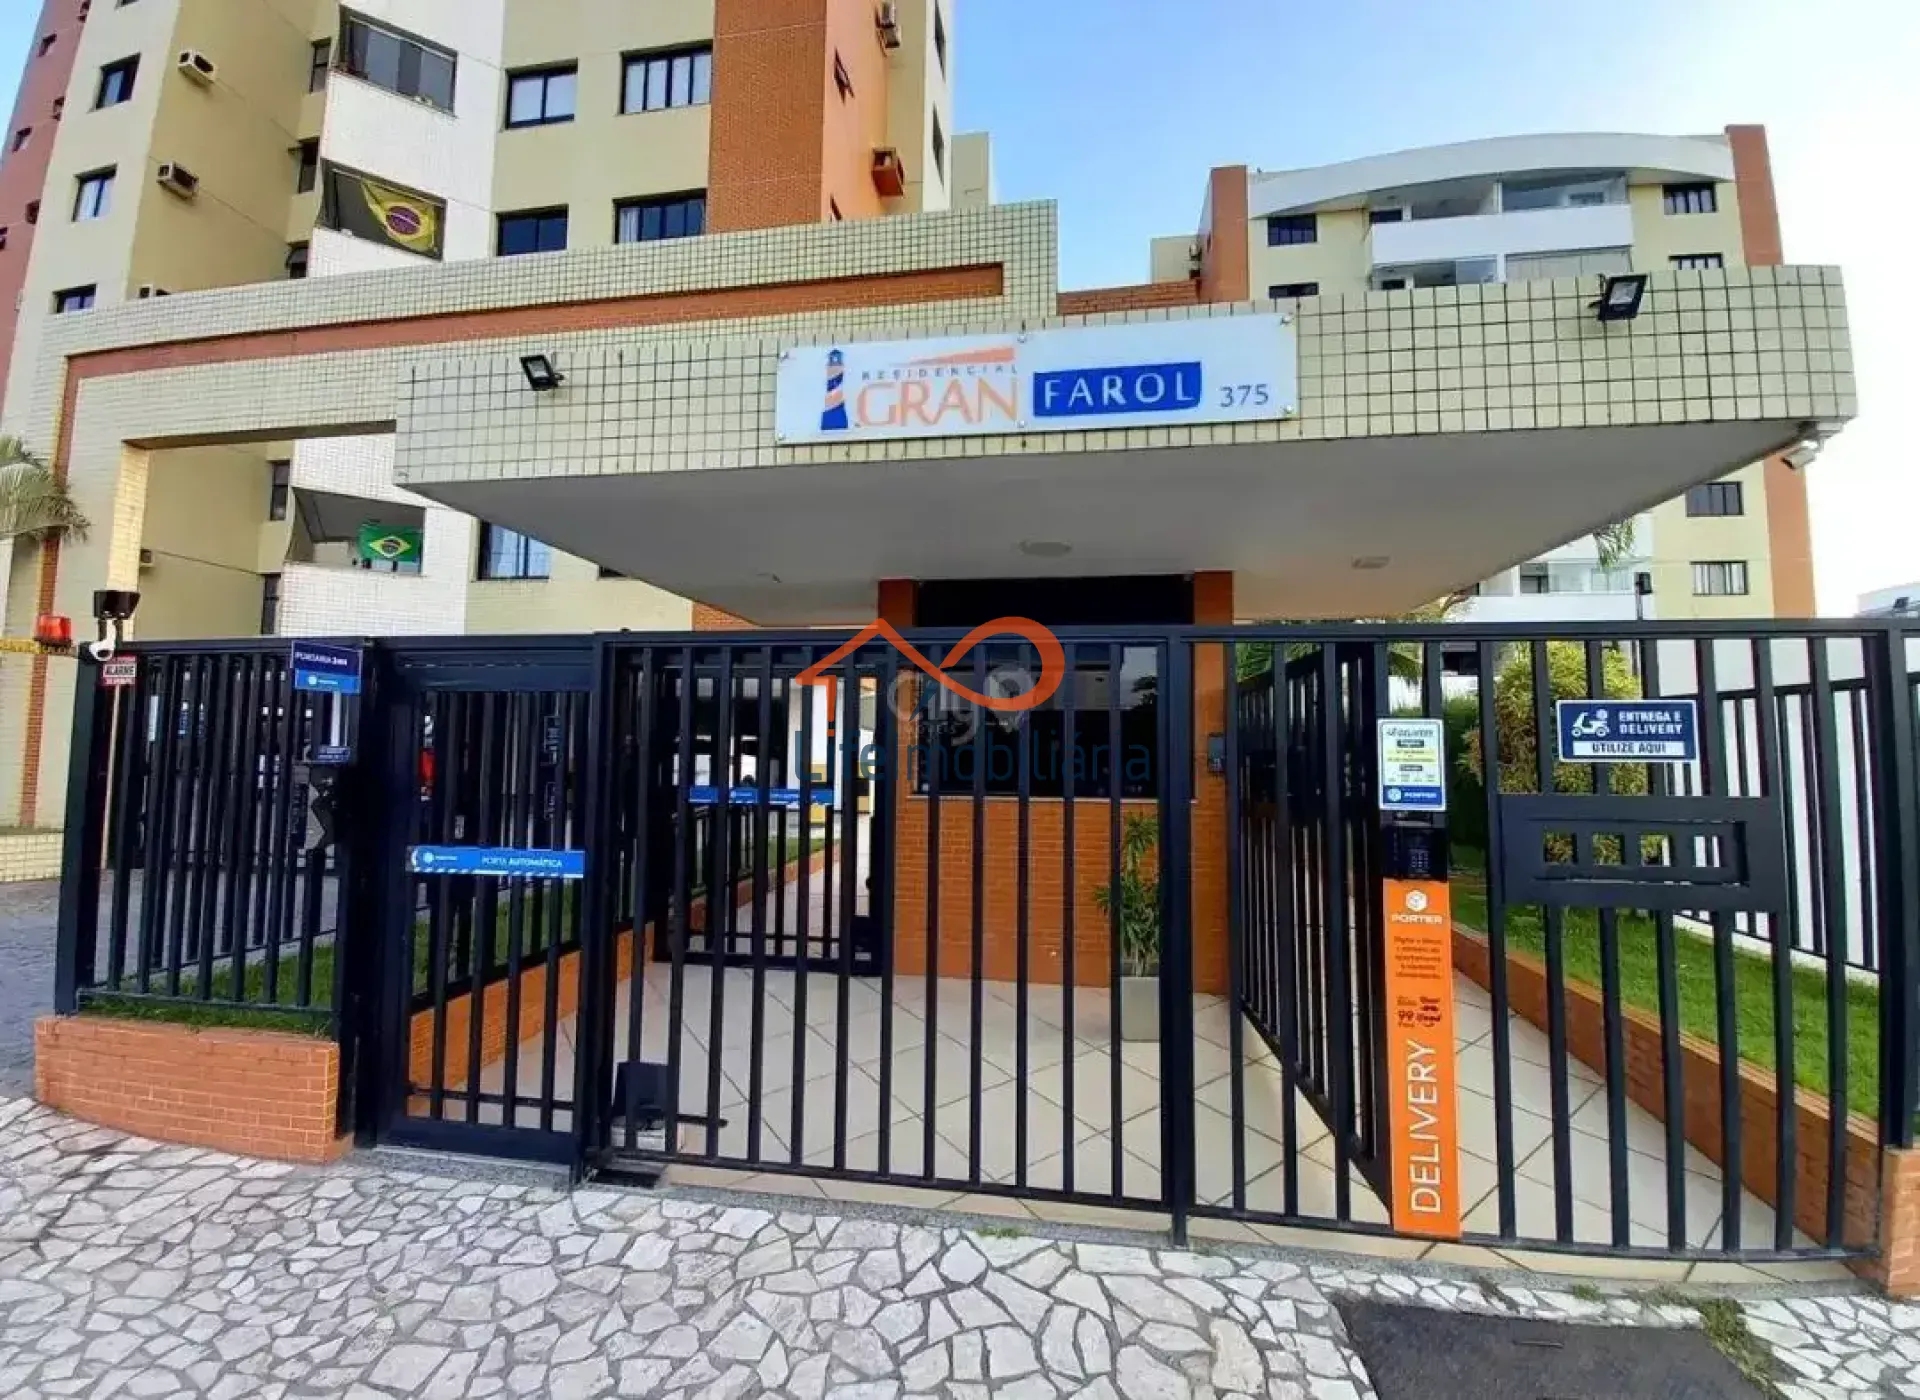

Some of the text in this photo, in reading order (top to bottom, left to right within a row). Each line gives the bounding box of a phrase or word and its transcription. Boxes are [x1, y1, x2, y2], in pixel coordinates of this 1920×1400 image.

[861, 363, 1019, 381] RESIDENCIAL
[857, 370, 1270, 427] GRAN FAROL 375
[1618, 710, 1681, 722] ENTREGA E
[1619, 724, 1683, 735] DELIVERY
[1592, 741, 1667, 754] UTILIZE AQUI
[482, 856, 506, 866] PORTA
[1407, 1040, 1441, 1213] DELIVERY
